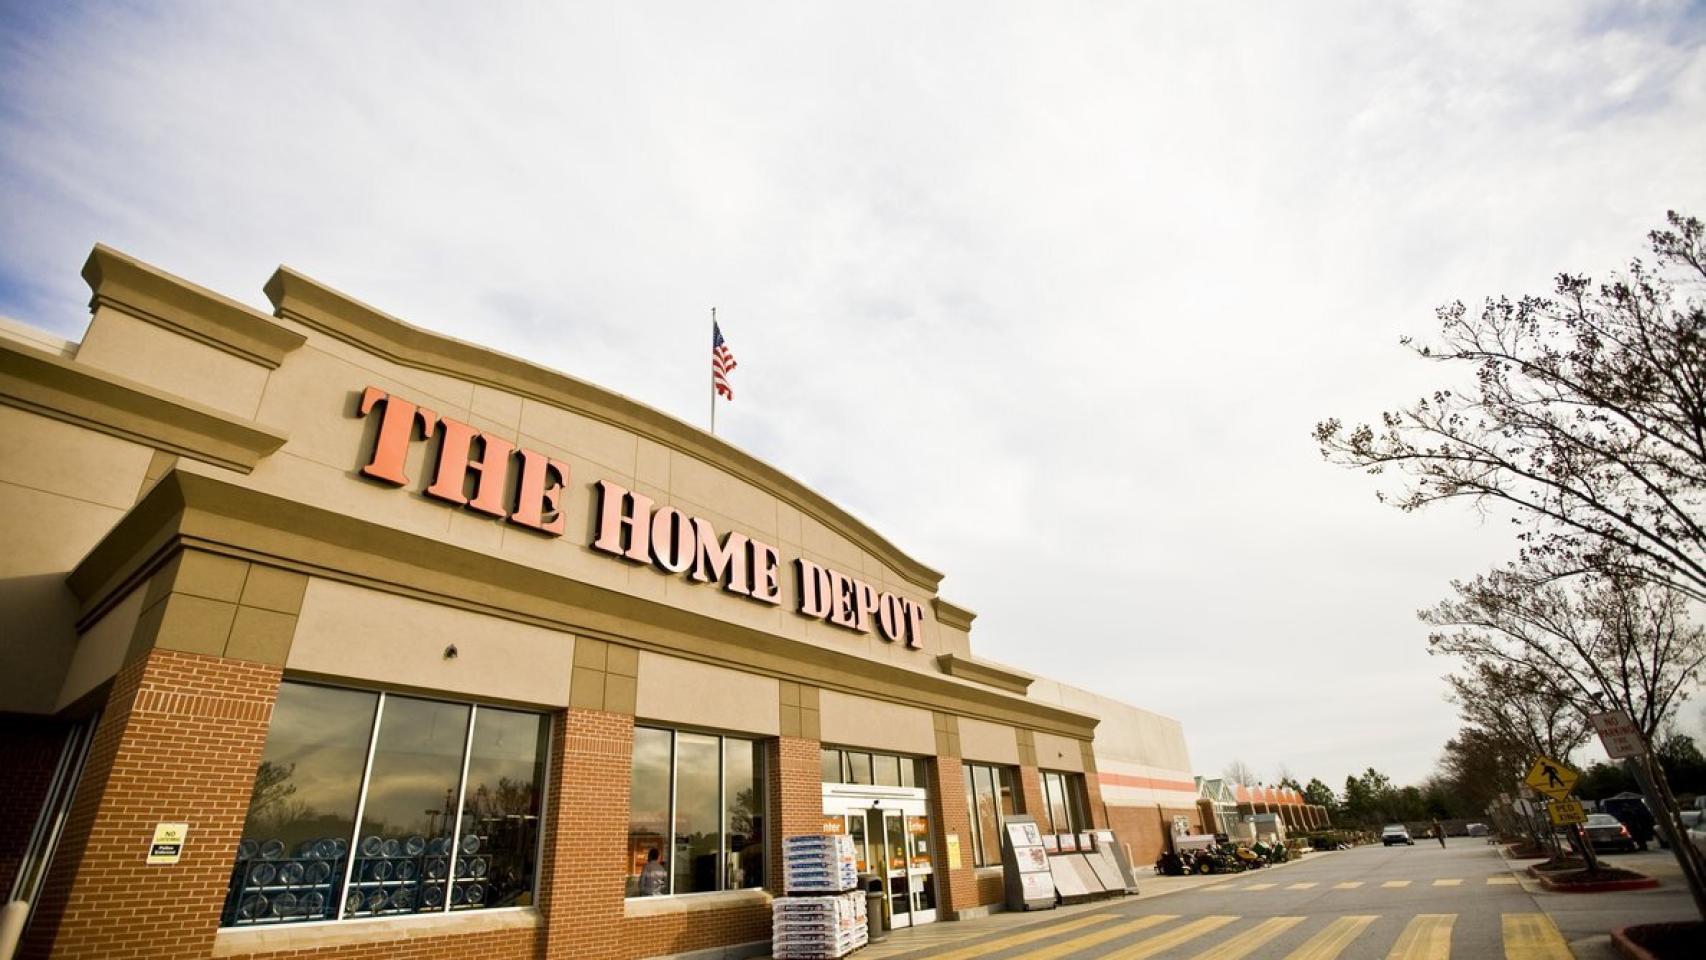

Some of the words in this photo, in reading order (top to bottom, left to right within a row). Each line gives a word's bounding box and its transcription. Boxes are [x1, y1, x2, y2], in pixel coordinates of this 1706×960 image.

[358, 386, 571, 537] THE
[593, 480, 782, 605] HOME
[795, 558, 925, 650] DEPOT
[823, 822, 841, 832] nter
